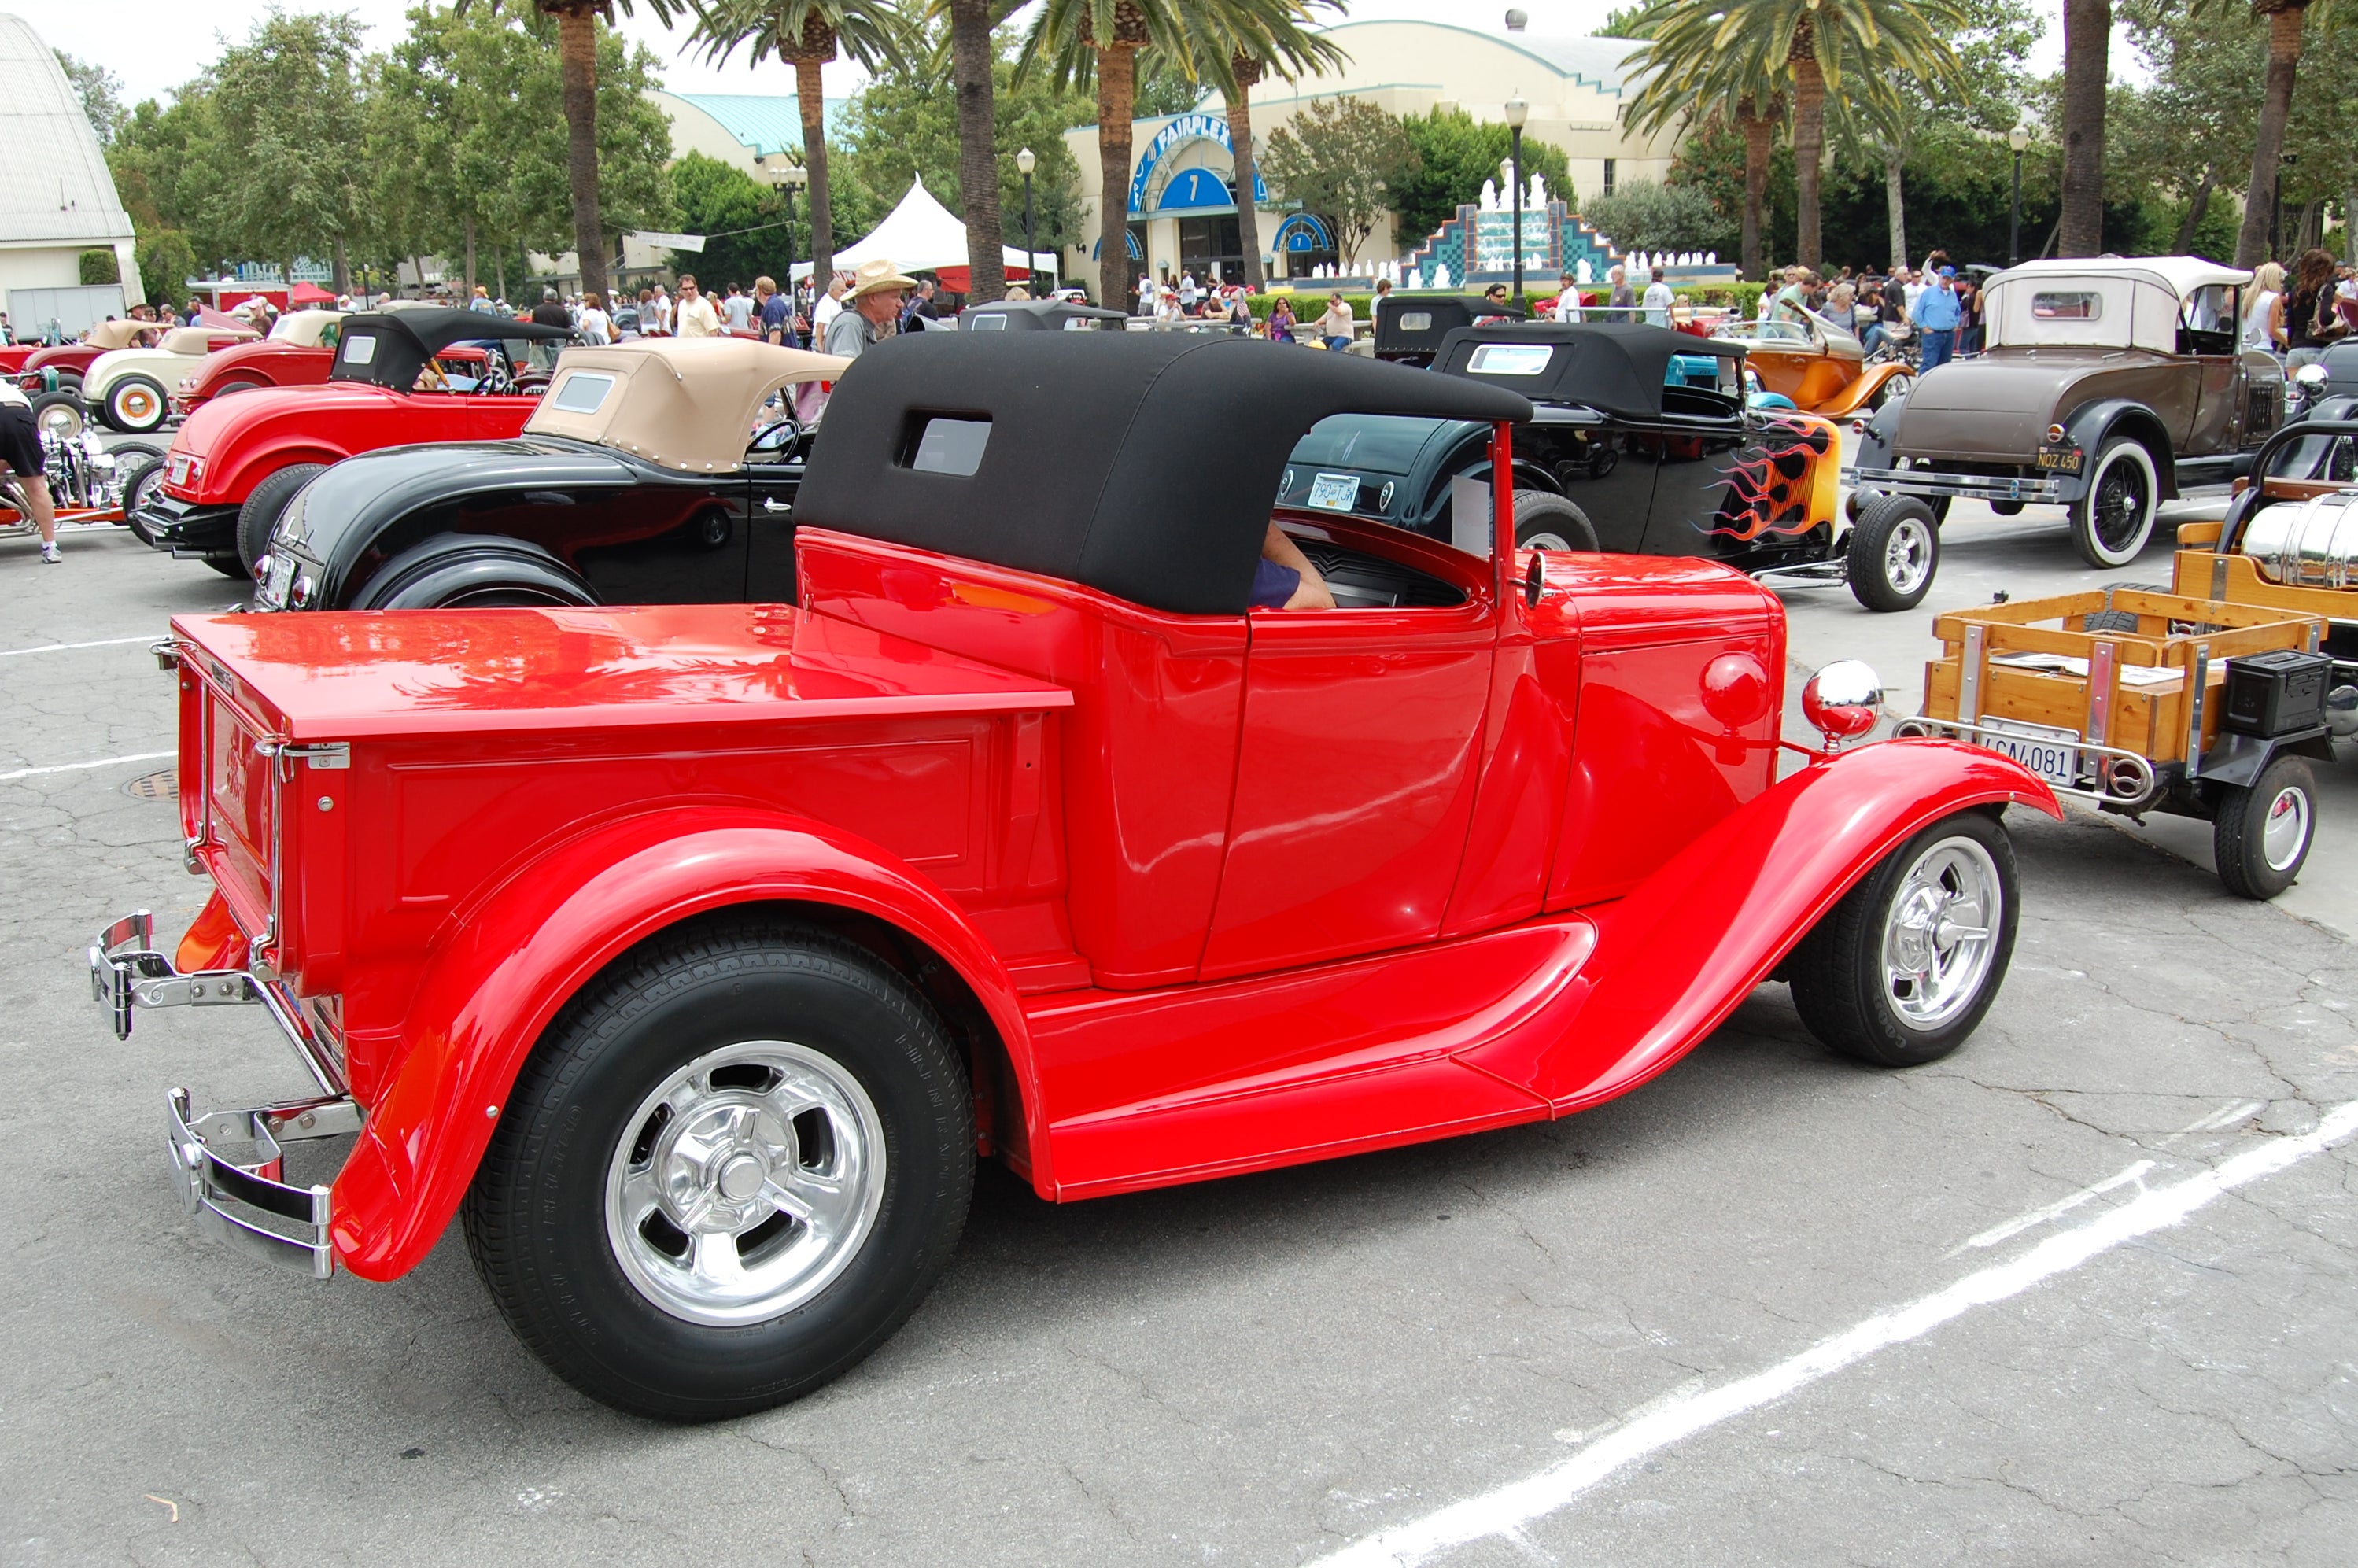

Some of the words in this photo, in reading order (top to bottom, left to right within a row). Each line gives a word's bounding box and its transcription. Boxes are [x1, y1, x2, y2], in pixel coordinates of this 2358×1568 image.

[1157, 115, 1230, 151] FAIRPLEX
[1189, 174, 1199, 201] 7
[2038, 453, 2060, 469] NOZ
[2060, 455, 2079, 470] 450
